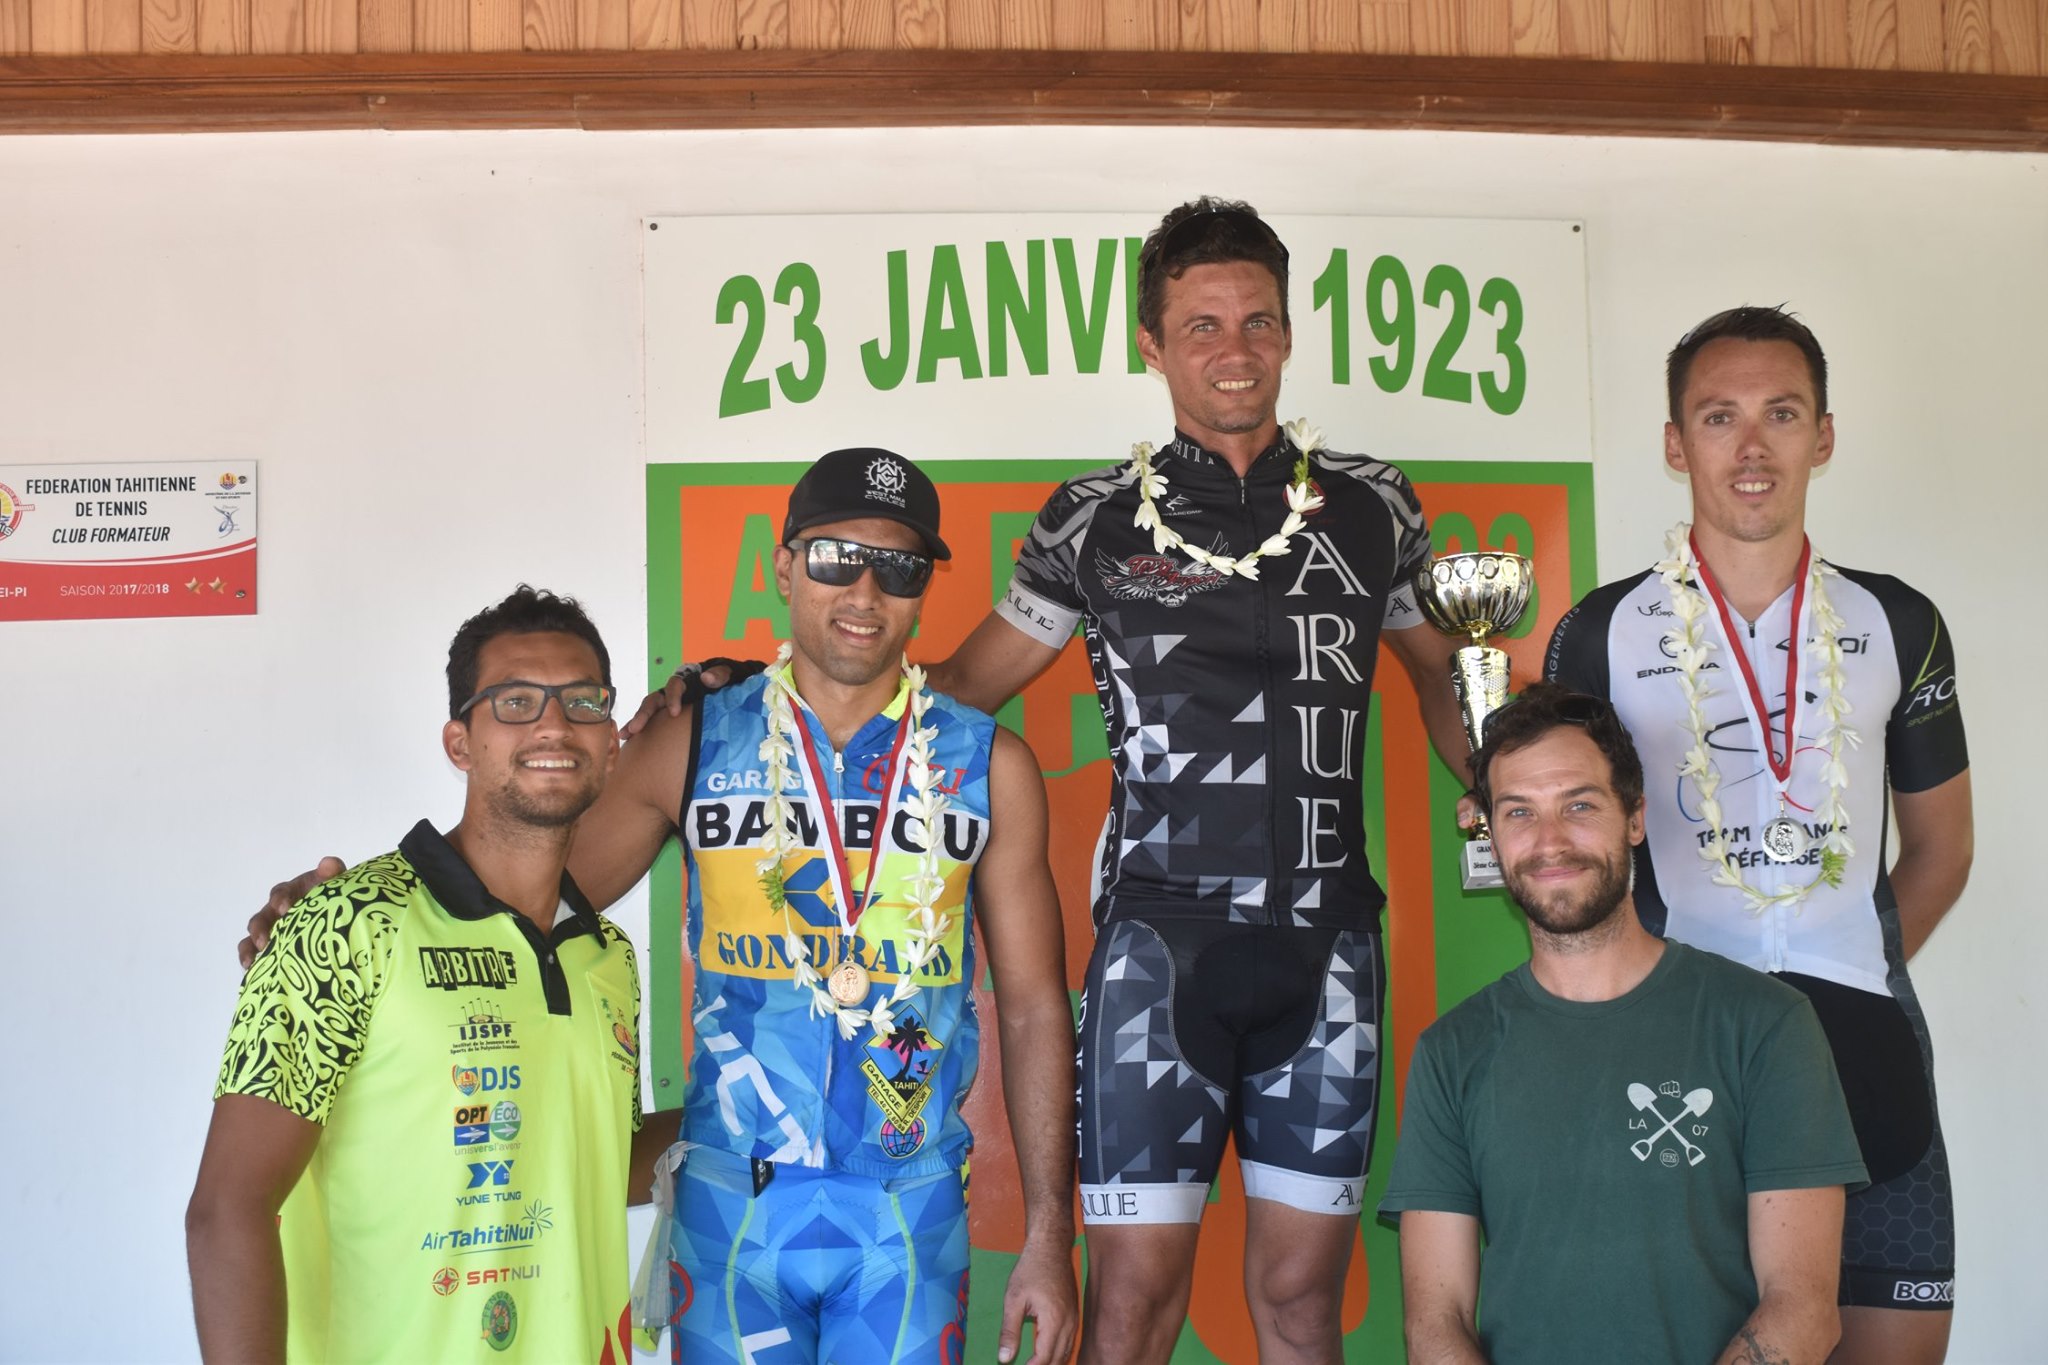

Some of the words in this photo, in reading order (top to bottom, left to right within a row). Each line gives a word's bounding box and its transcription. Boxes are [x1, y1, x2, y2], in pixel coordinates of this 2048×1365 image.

[715, 261, 826, 417] 23
[860, 236, 1147, 392] JANVI
[1312, 247, 1527, 416] 1923
[26, 478, 109, 495] FEDERATION
[115, 476, 197, 493] TAHITIENNE
[75, 502, 93, 517] DE
[96, 500, 147, 516] TENNIS
[52, 528, 87, 544] CLUB
[90, 526, 170, 543] FORMATEUR
[60, 585, 105, 597] SAISON
[109, 584, 170, 596] 2017/2018
[1636, 661, 1721, 679] ENDA
[1285, 531, 1371, 870] ARUE
[419, 947, 518, 991] ARBITRE
[460, 1023, 513, 1041] IJSPF
[481, 1065, 521, 1092] DJS
[866, 1063, 902, 1111] GARAGE
[456, 1106, 488, 1125] OPT
[1628, 1118, 1648, 1130] LA
[1692, 1124, 1709, 1137] 07
[456, 1193, 490, 1207] YUNE
[494, 1190, 522, 1203] TUNG
